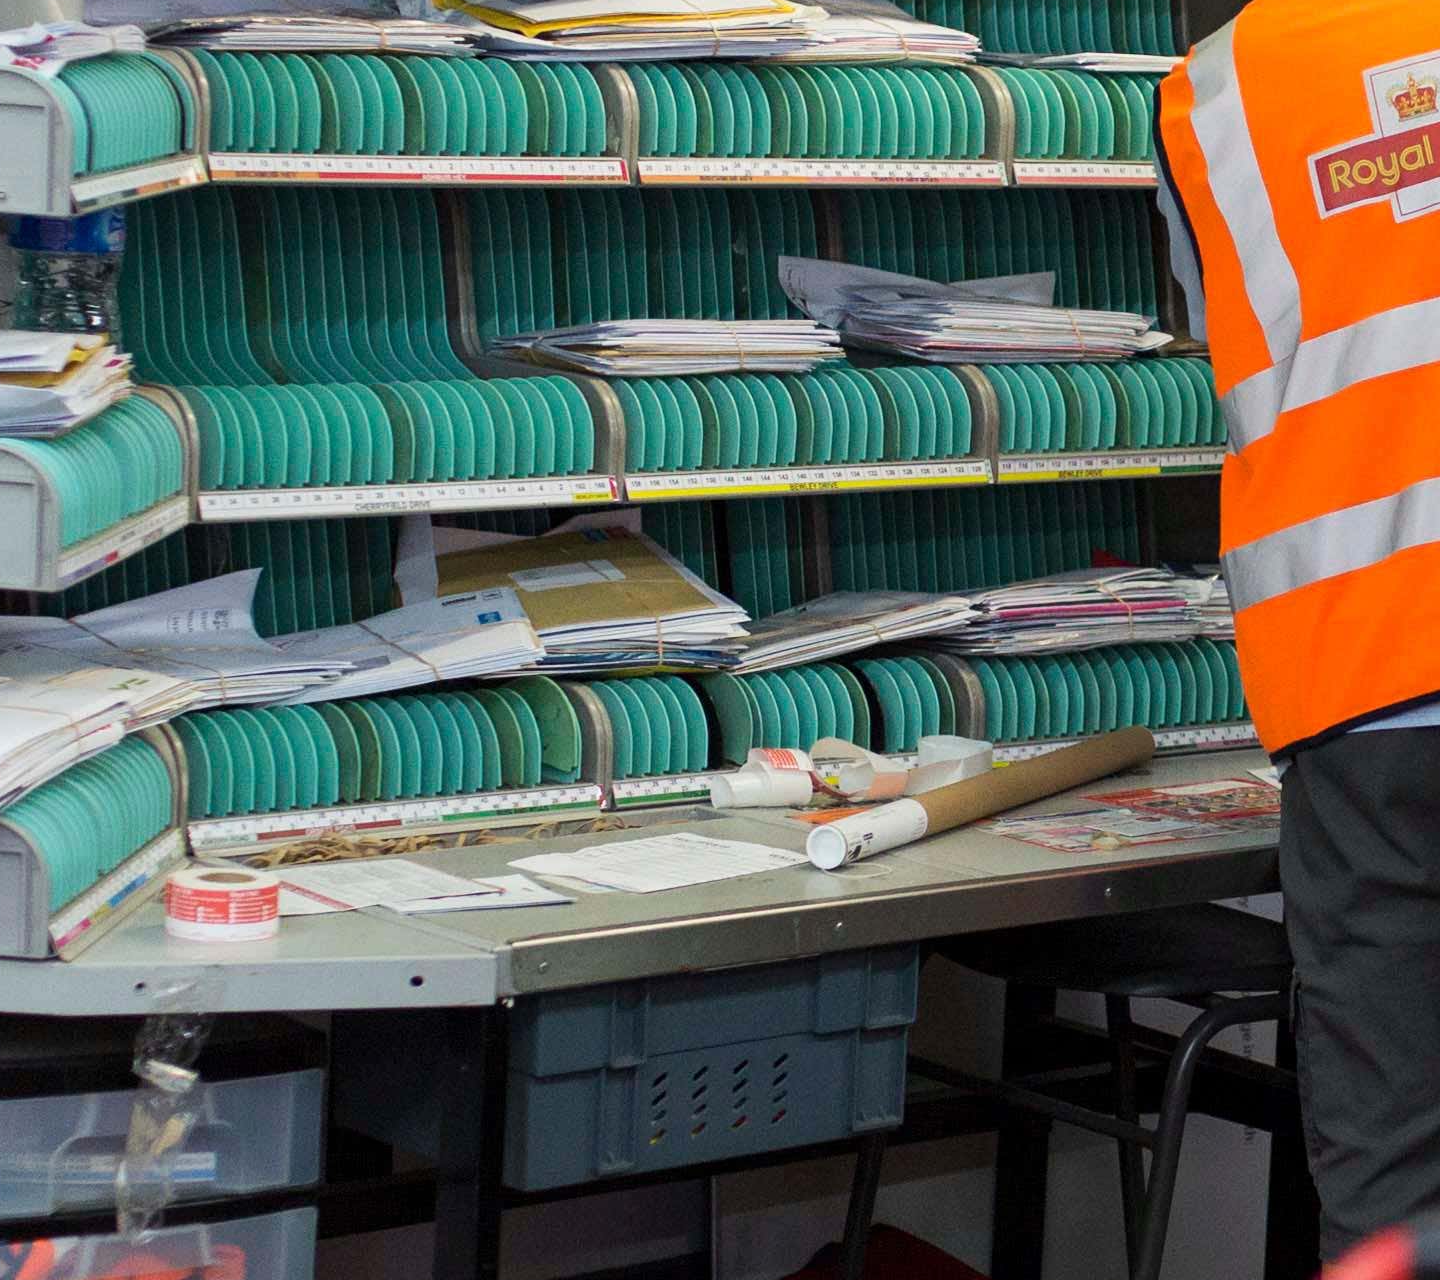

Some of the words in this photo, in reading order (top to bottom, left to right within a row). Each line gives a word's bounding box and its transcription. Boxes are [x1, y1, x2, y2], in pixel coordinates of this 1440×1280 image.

[1327, 135, 1434, 194] Royal
[355, 501, 407, 512] CHERRYFIELD
[408, 500, 431, 510] DRIVE
